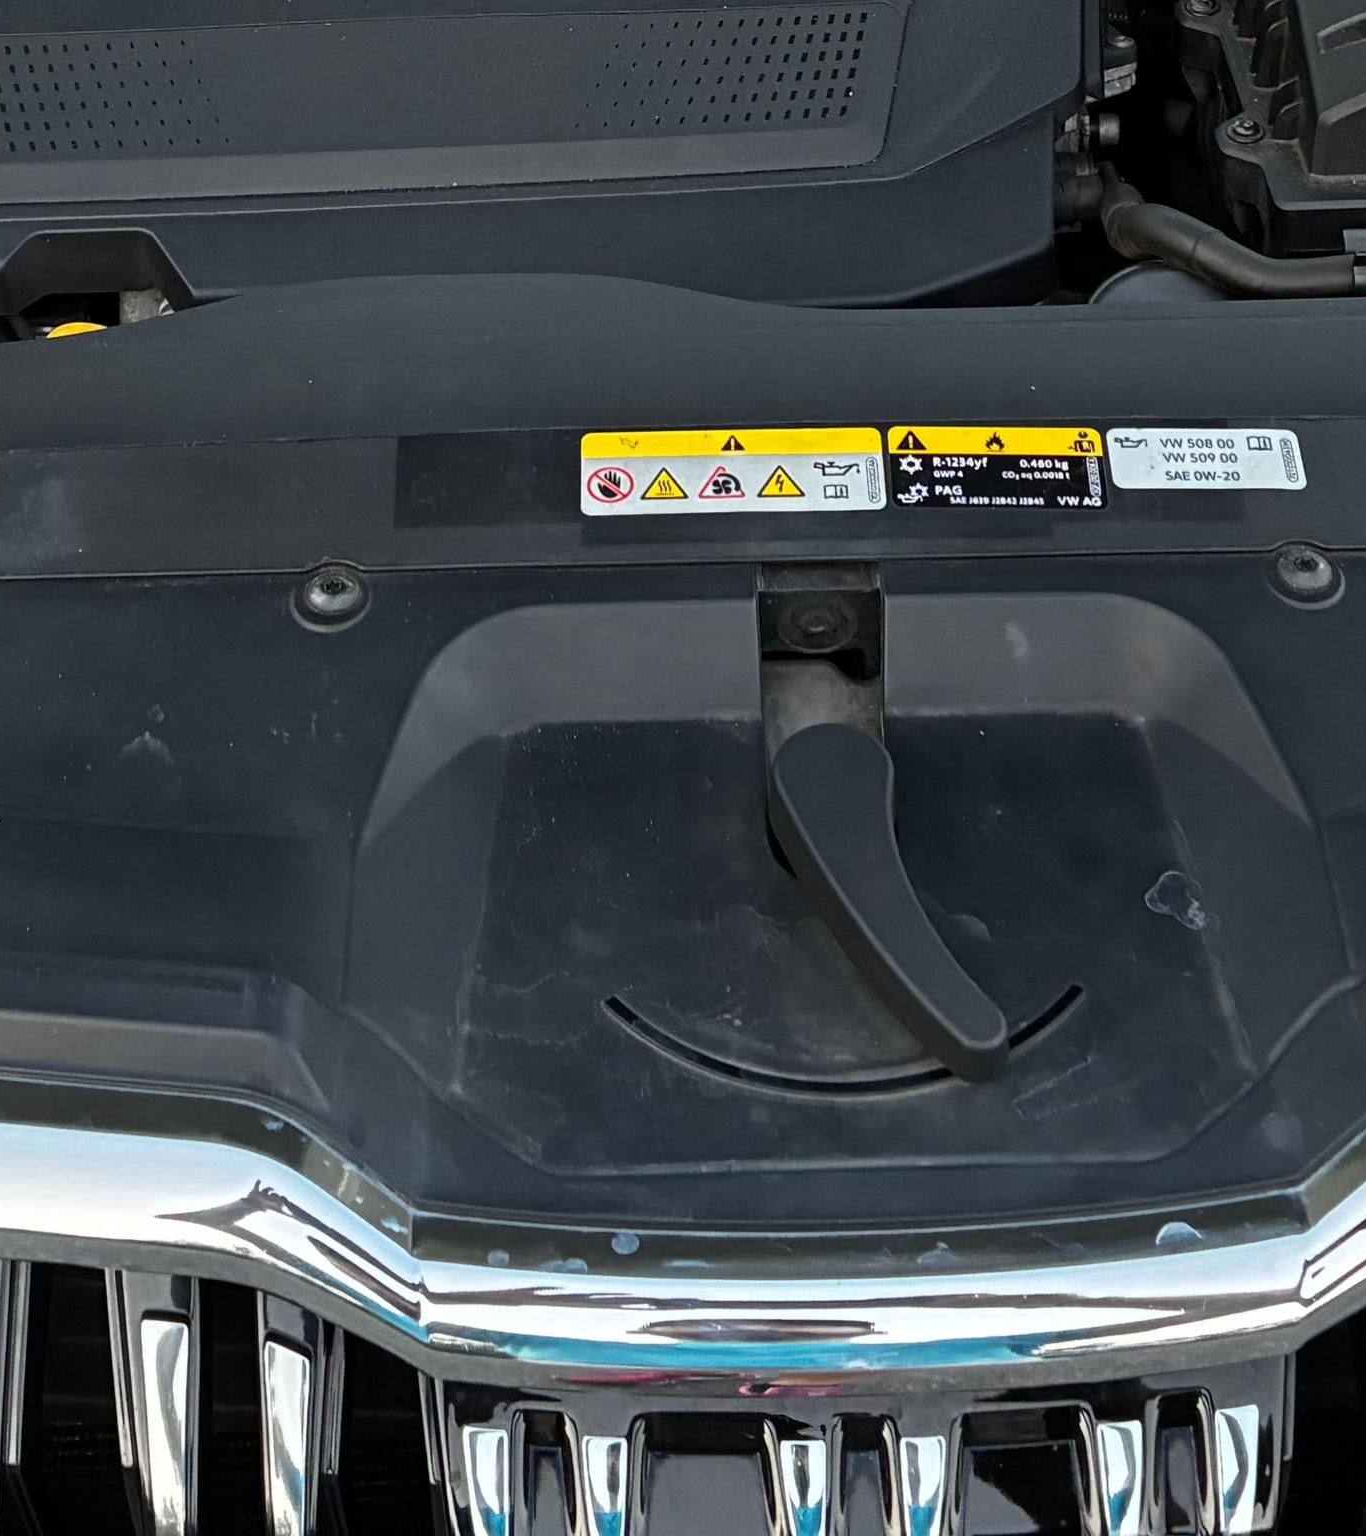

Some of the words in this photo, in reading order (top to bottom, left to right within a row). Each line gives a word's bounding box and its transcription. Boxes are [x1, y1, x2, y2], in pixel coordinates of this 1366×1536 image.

[1159, 438, 1183, 449] VW
[1187, 438, 1213, 449] 508
[1217, 438, 1235, 449] 00
[932, 456, 988, 470] R-1234yf
[1055, 459, 1069, 471] kg
[1162, 453, 1186, 463] VW
[1190, 453, 1216, 463] 509
[1219, 453, 1238, 463] 00
[933, 470, 956, 478] GWP
[957, 470, 964, 478] 4
[1020, 471, 1033, 480] eq
[1165, 470, 1191, 481] SAE
[1194, 470, 1241, 481] 0W-20
[935, 484, 964, 496] PAG
[949, 496, 967, 505] SAE
[1057, 495, 1080, 506] VW
[1082, 495, 1103, 507] AG
